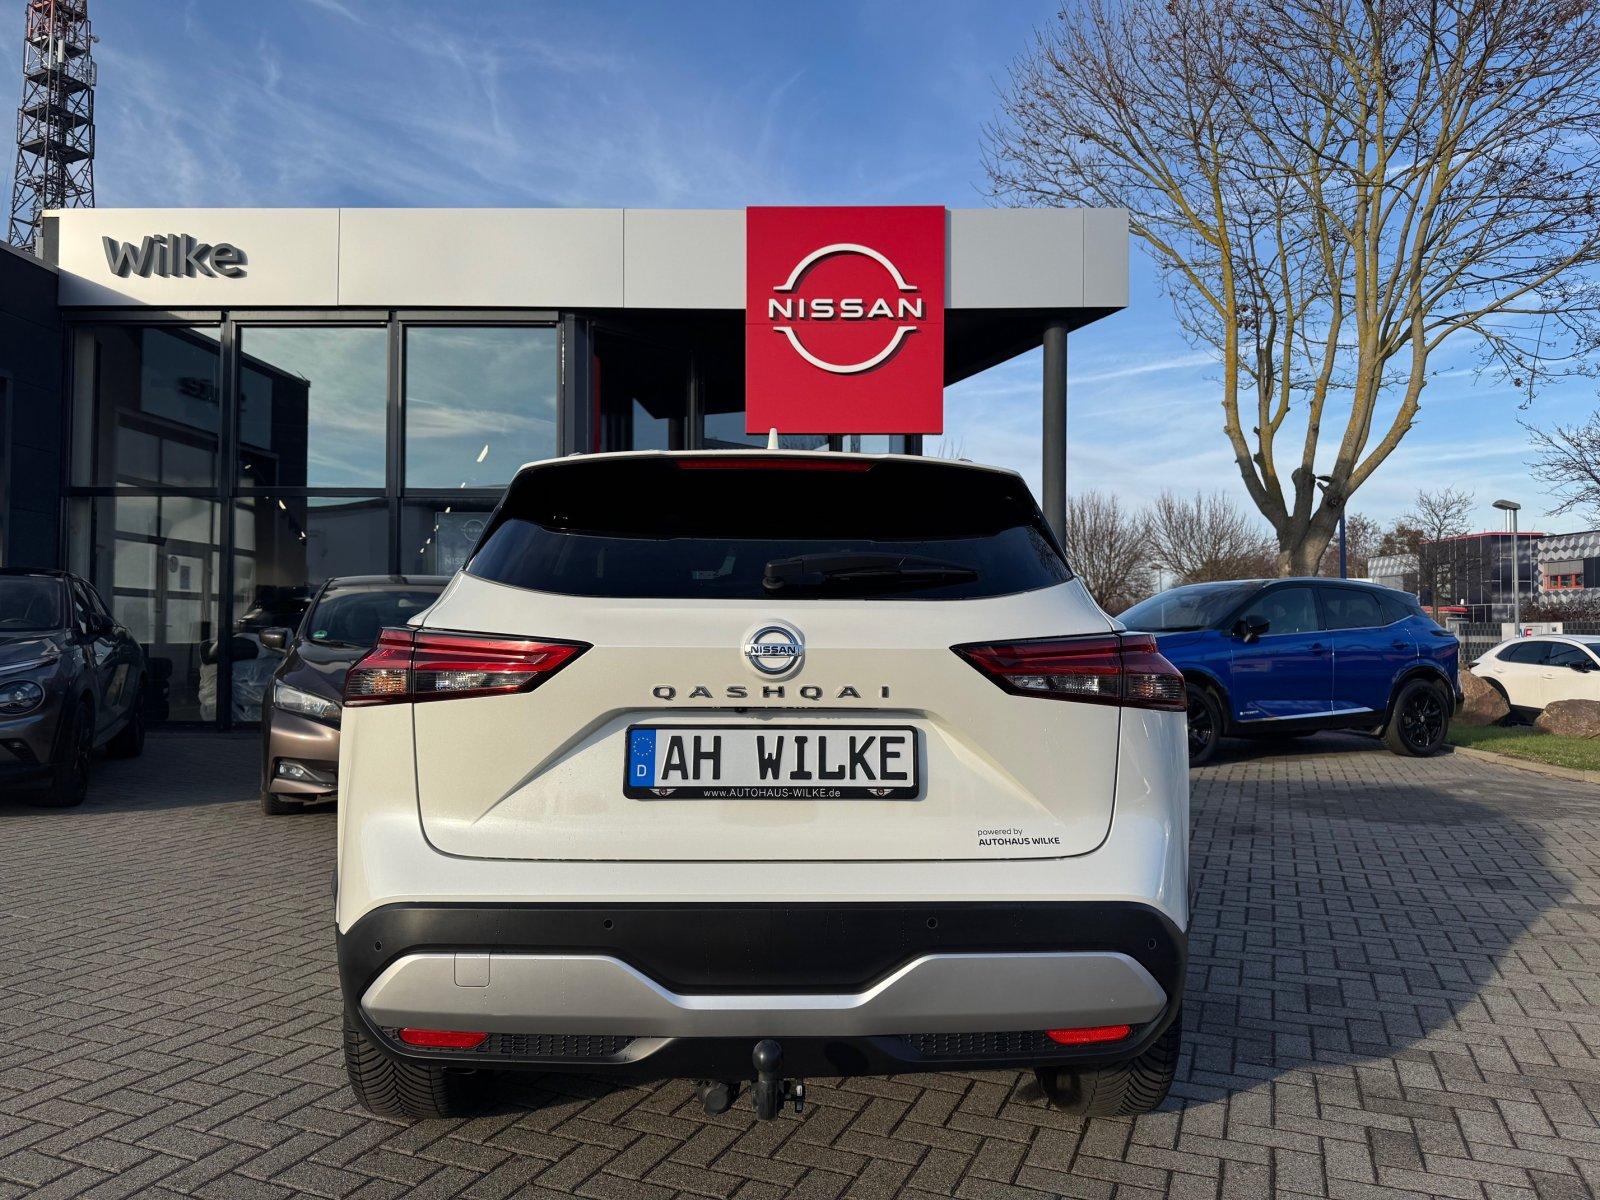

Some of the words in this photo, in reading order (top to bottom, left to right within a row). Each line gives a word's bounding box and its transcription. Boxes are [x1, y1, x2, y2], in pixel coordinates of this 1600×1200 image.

[102, 233, 248, 278] Wilke
[768, 298, 923, 319] NISSAN
[750, 646, 796, 654] NISSAN
[652, 685, 890, 700] QASHQAI
[661, 735, 722, 780] AH
[756, 735, 908, 780] WILKE
[636, 764, 647, 777] D
[703, 788, 841, 798] www.AUTOHAUS-WILKE.de
[977, 828, 1012, 838] powered
[1013, 828, 1023, 836] by
[979, 838, 1031, 846] AUTOHAUS
[1032, 837, 1061, 845] WILKE
